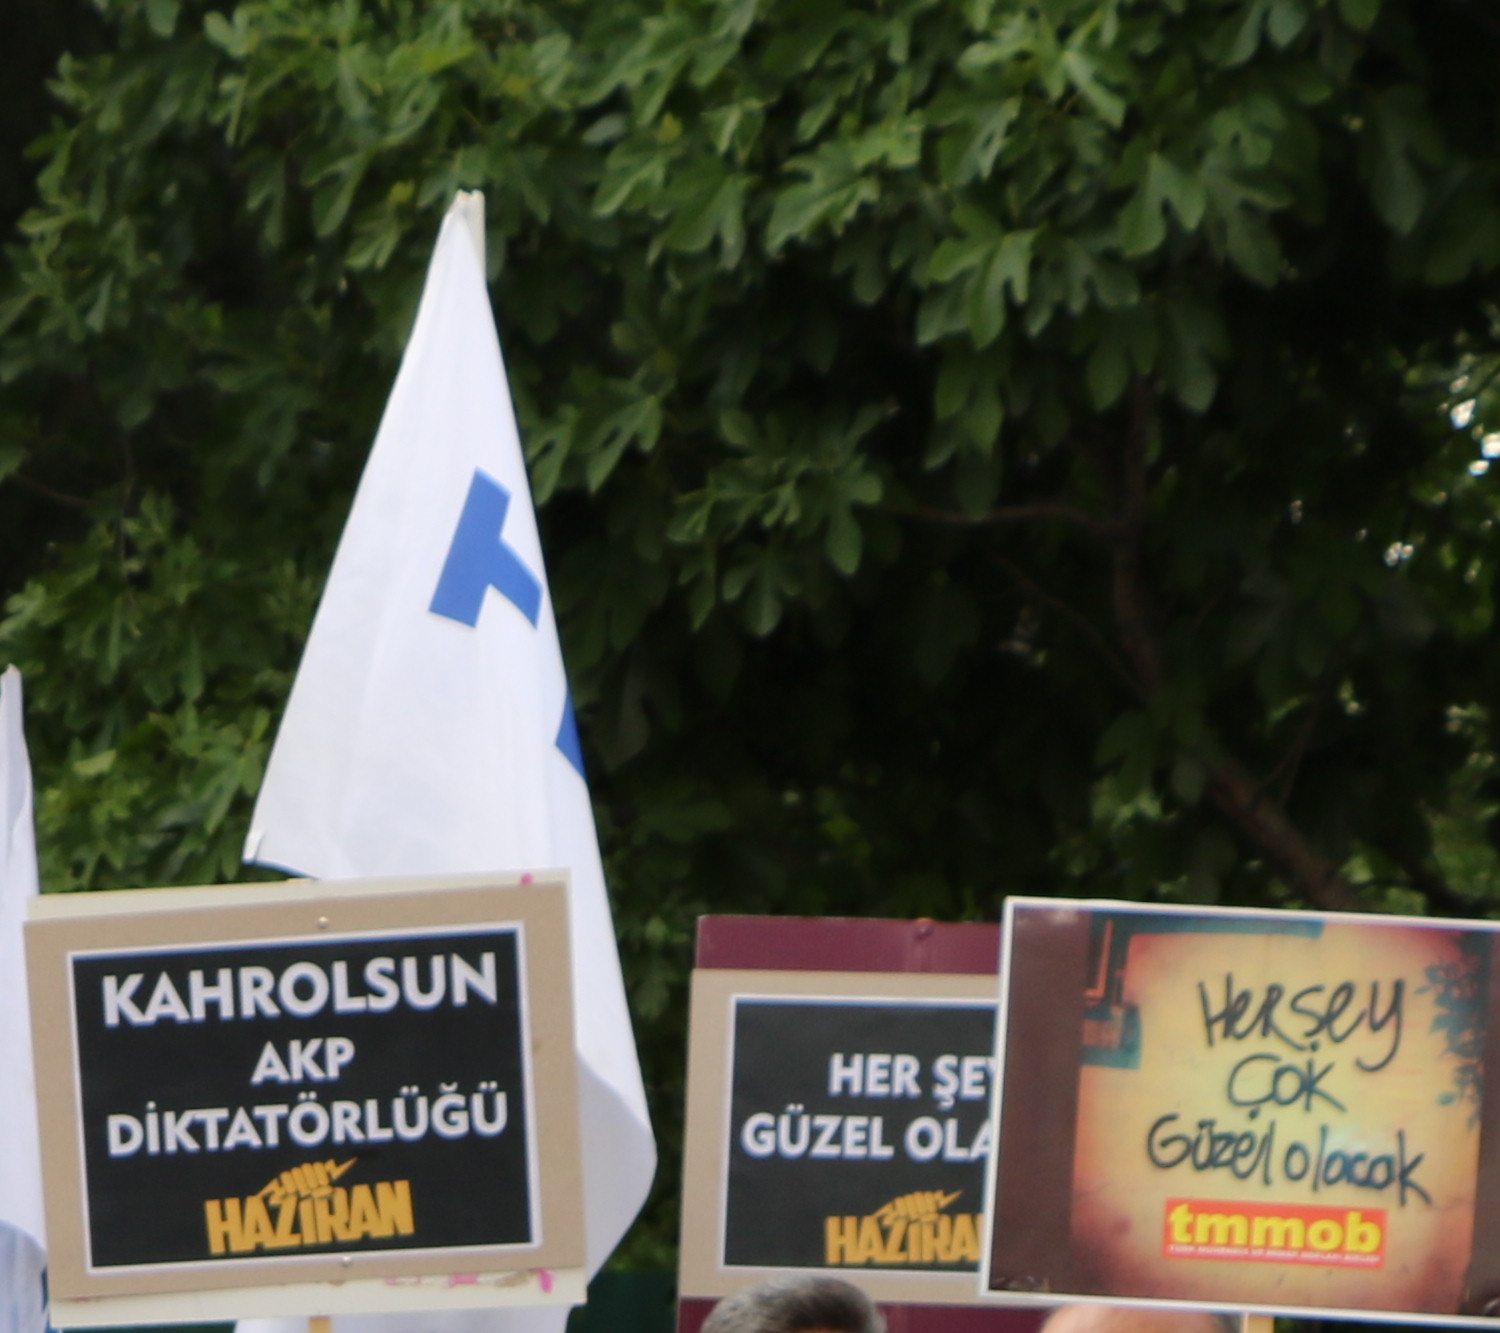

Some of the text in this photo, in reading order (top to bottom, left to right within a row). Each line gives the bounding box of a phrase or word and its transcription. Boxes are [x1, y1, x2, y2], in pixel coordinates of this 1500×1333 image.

[102, 952, 498, 1027] KAHROLSUN
[251, 1037, 355, 1086] AKP
[828, 1053, 921, 1098] HER
[107, 1081, 508, 1157] DİKTATÖRLÜĞÜ
[741, 1103, 895, 1160] GÜZEL
[825, 1213, 985, 1265] HAZİRA
[1169, 1203, 1382, 1253] tmmob
